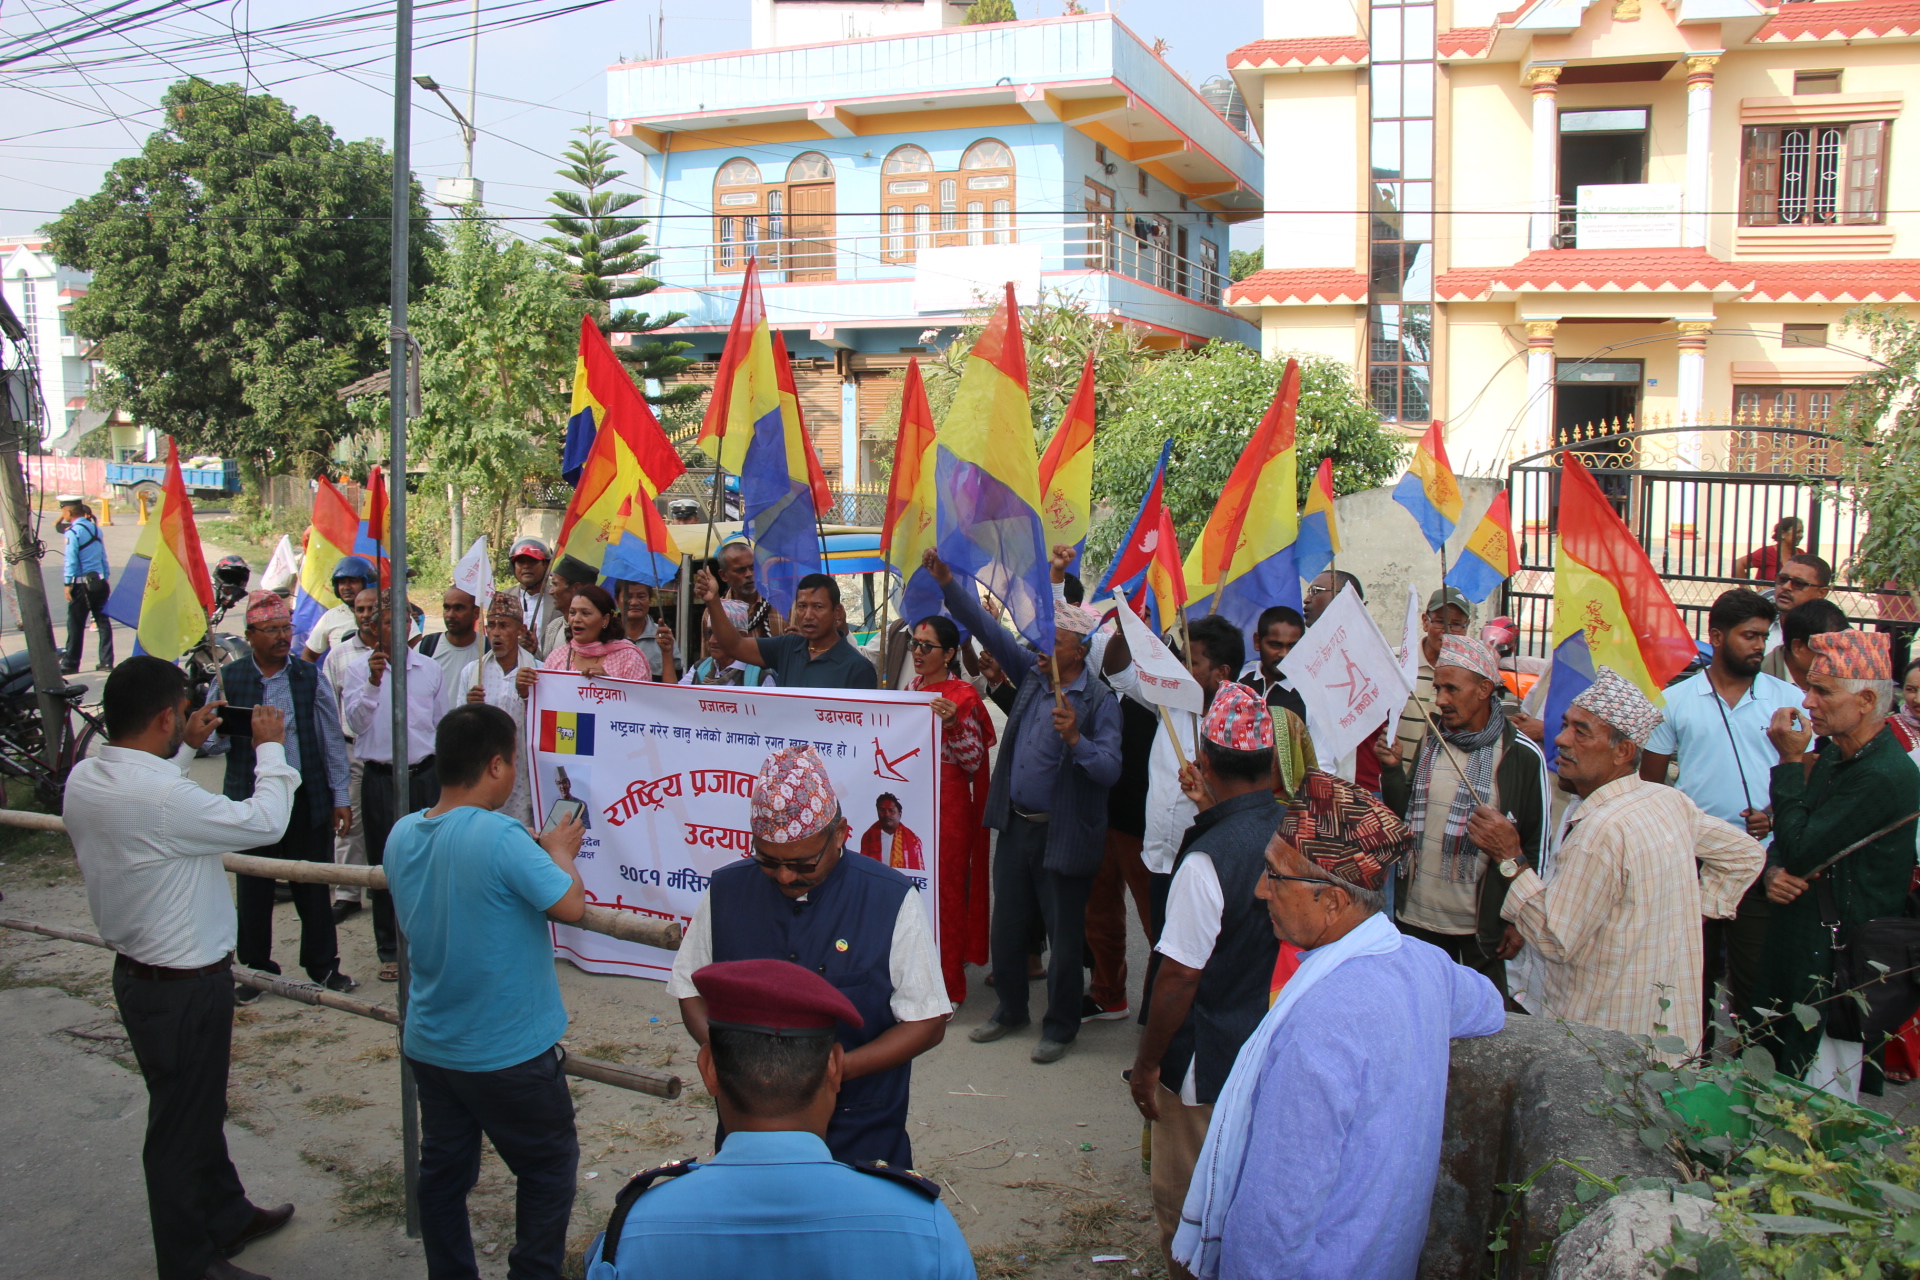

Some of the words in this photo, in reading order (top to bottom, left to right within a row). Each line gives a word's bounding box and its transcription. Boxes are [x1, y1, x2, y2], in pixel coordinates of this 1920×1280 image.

[1160, 678, 1182, 689] हलो
[649, 722, 669, 740] गरेर
[673, 726, 692, 744] खानु
[695, 726, 722, 743] भनेको
[725, 731, 761, 748] आमाको
[764, 736, 785, 751] रगत
[837, 740, 847, 758] हो
[603, 773, 683, 827] राष्ट्रिय
[689, 769, 759, 799] प्रजात
[684, 822, 754, 858] उदयपु
[620, 864, 660, 887] २०८१
